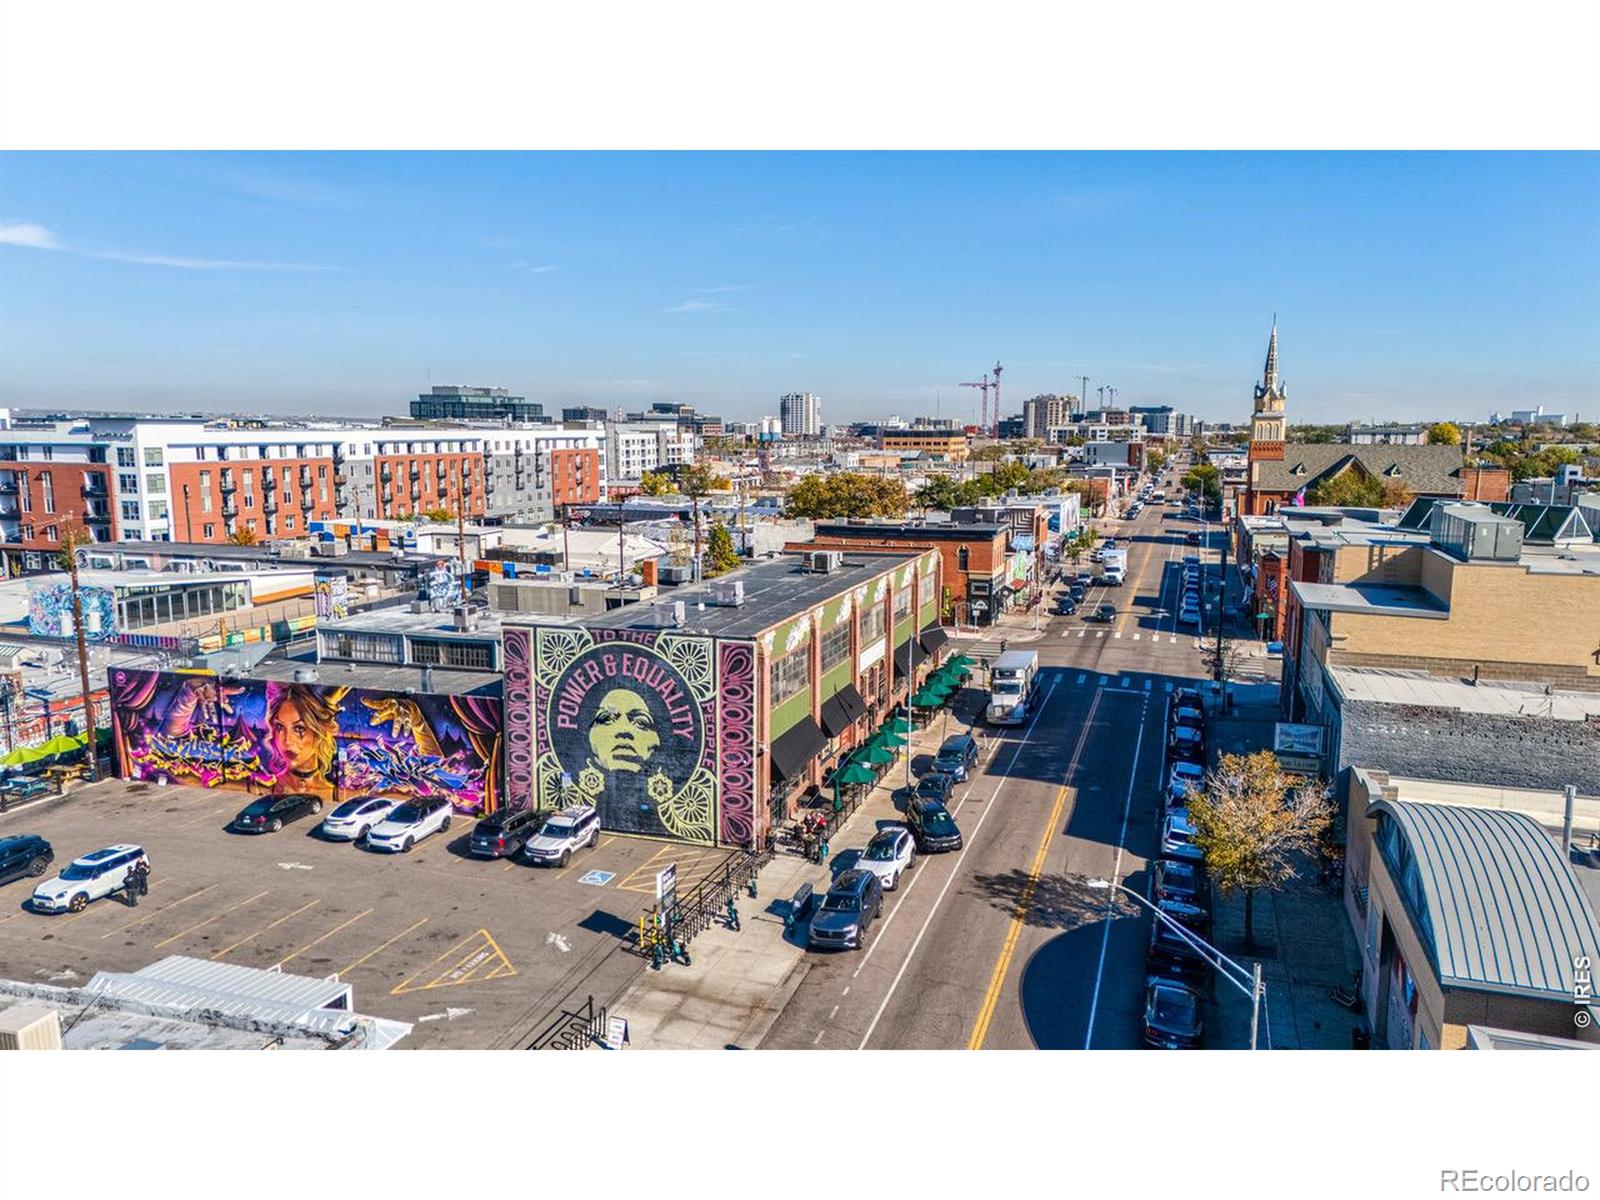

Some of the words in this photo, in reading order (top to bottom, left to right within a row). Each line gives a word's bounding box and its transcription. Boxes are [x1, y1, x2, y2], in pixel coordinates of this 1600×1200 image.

[620, 631, 657, 646] THE
[536, 685, 550, 755] POWER
[557, 660, 604, 729] POWER
[603, 654, 617, 677] &
[622, 653, 695, 741] EQUALITY
[701, 700, 717, 771] PEOPLE
